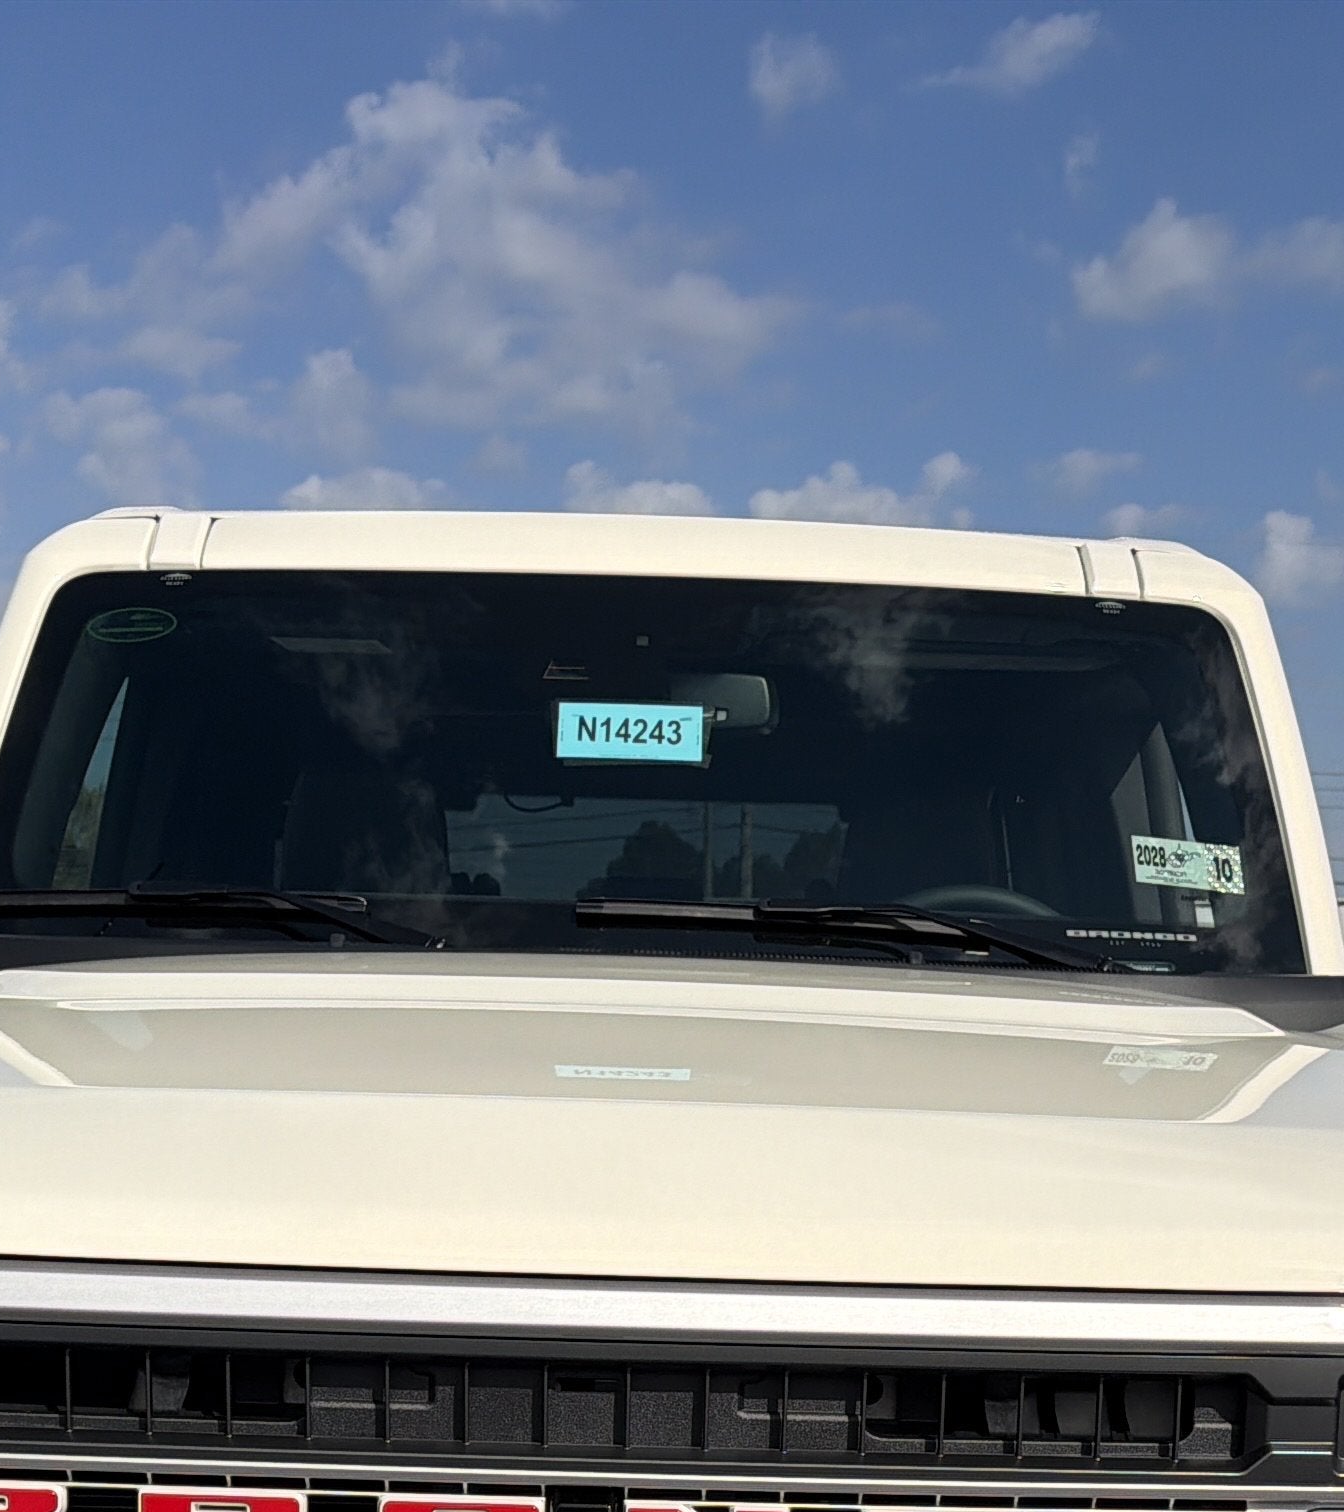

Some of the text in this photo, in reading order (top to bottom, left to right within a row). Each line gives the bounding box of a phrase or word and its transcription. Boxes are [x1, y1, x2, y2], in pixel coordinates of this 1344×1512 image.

[577, 715, 682, 745] N14243
[1136, 844, 1167, 868] 2028
[1213, 856, 1233, 883] 10
[1065, 929, 1198, 942] BRONCO
